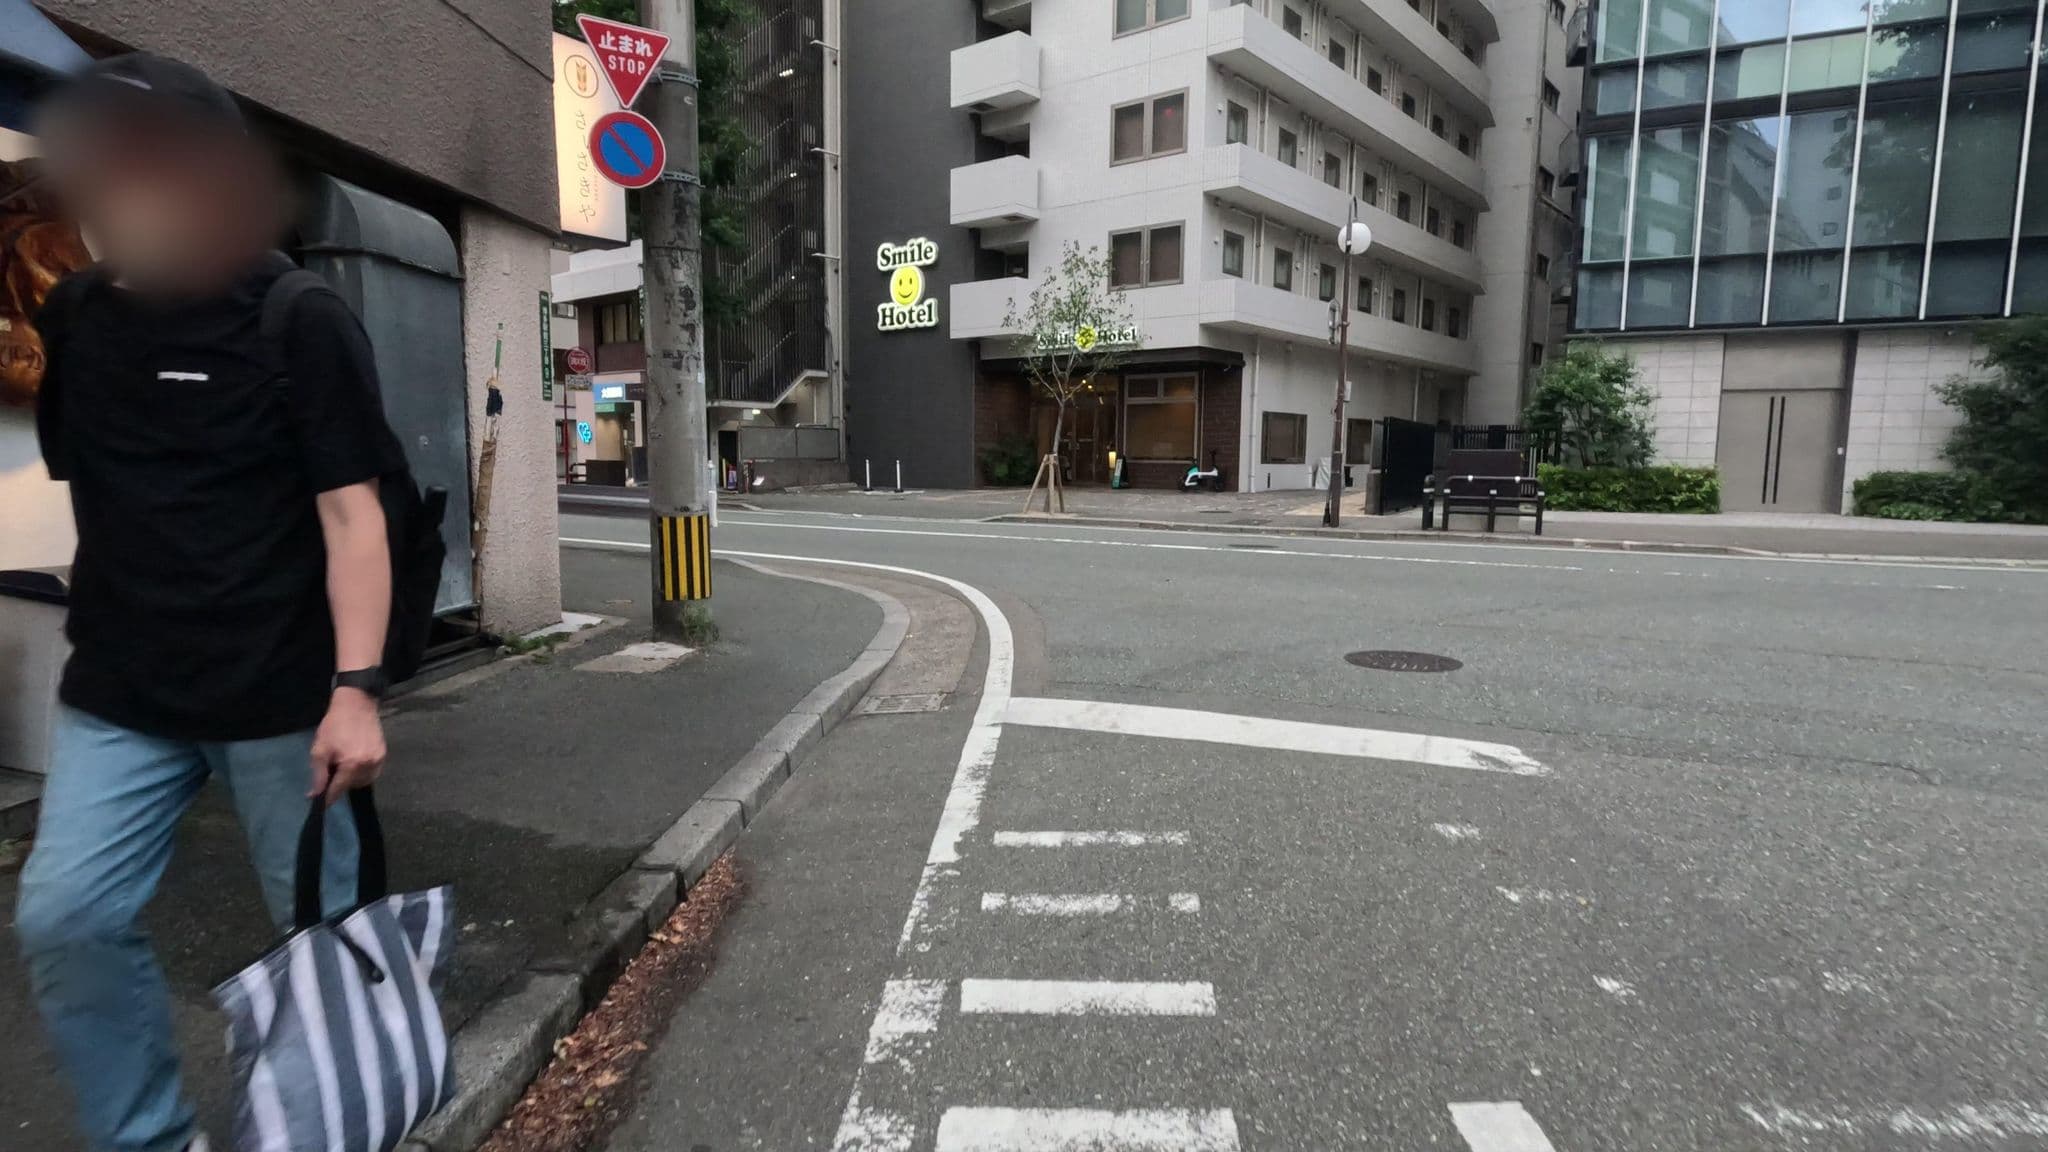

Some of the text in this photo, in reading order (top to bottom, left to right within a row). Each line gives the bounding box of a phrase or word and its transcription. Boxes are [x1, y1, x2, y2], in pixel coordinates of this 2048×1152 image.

[598, 30, 653, 57] 止まれ
[608, 54, 646, 75] STOP
[879, 242, 935, 268] Smile
[880, 302, 934, 328] Hotel
[1038, 330, 1075, 347] Sile
